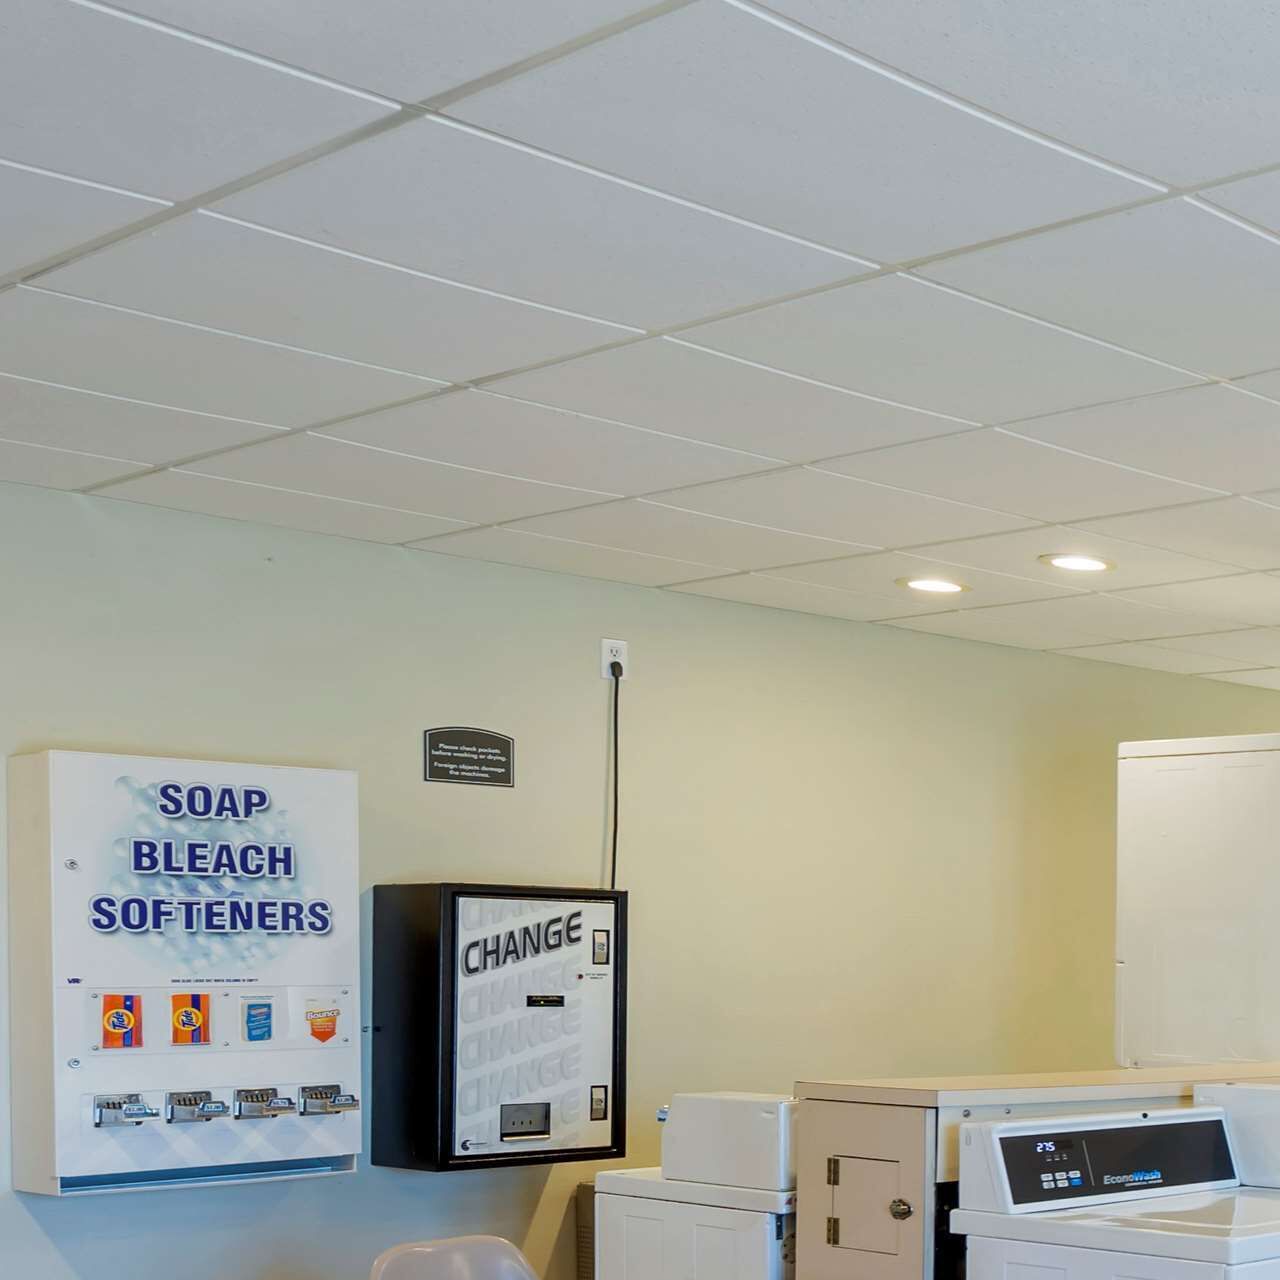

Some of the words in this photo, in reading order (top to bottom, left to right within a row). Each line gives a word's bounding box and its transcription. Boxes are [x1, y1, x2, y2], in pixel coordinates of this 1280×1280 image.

[158, 782, 269, 819] SOAP
[132, 839, 294, 877] BLEACH
[91, 897, 330, 932] SOFTENERS
[461, 911, 582, 976] CHANGE
[110, 1011, 128, 1031] Tide
[179, 1009, 197, 1029] Tide
[1103, 1169, 1162, 1185] EconoWash
